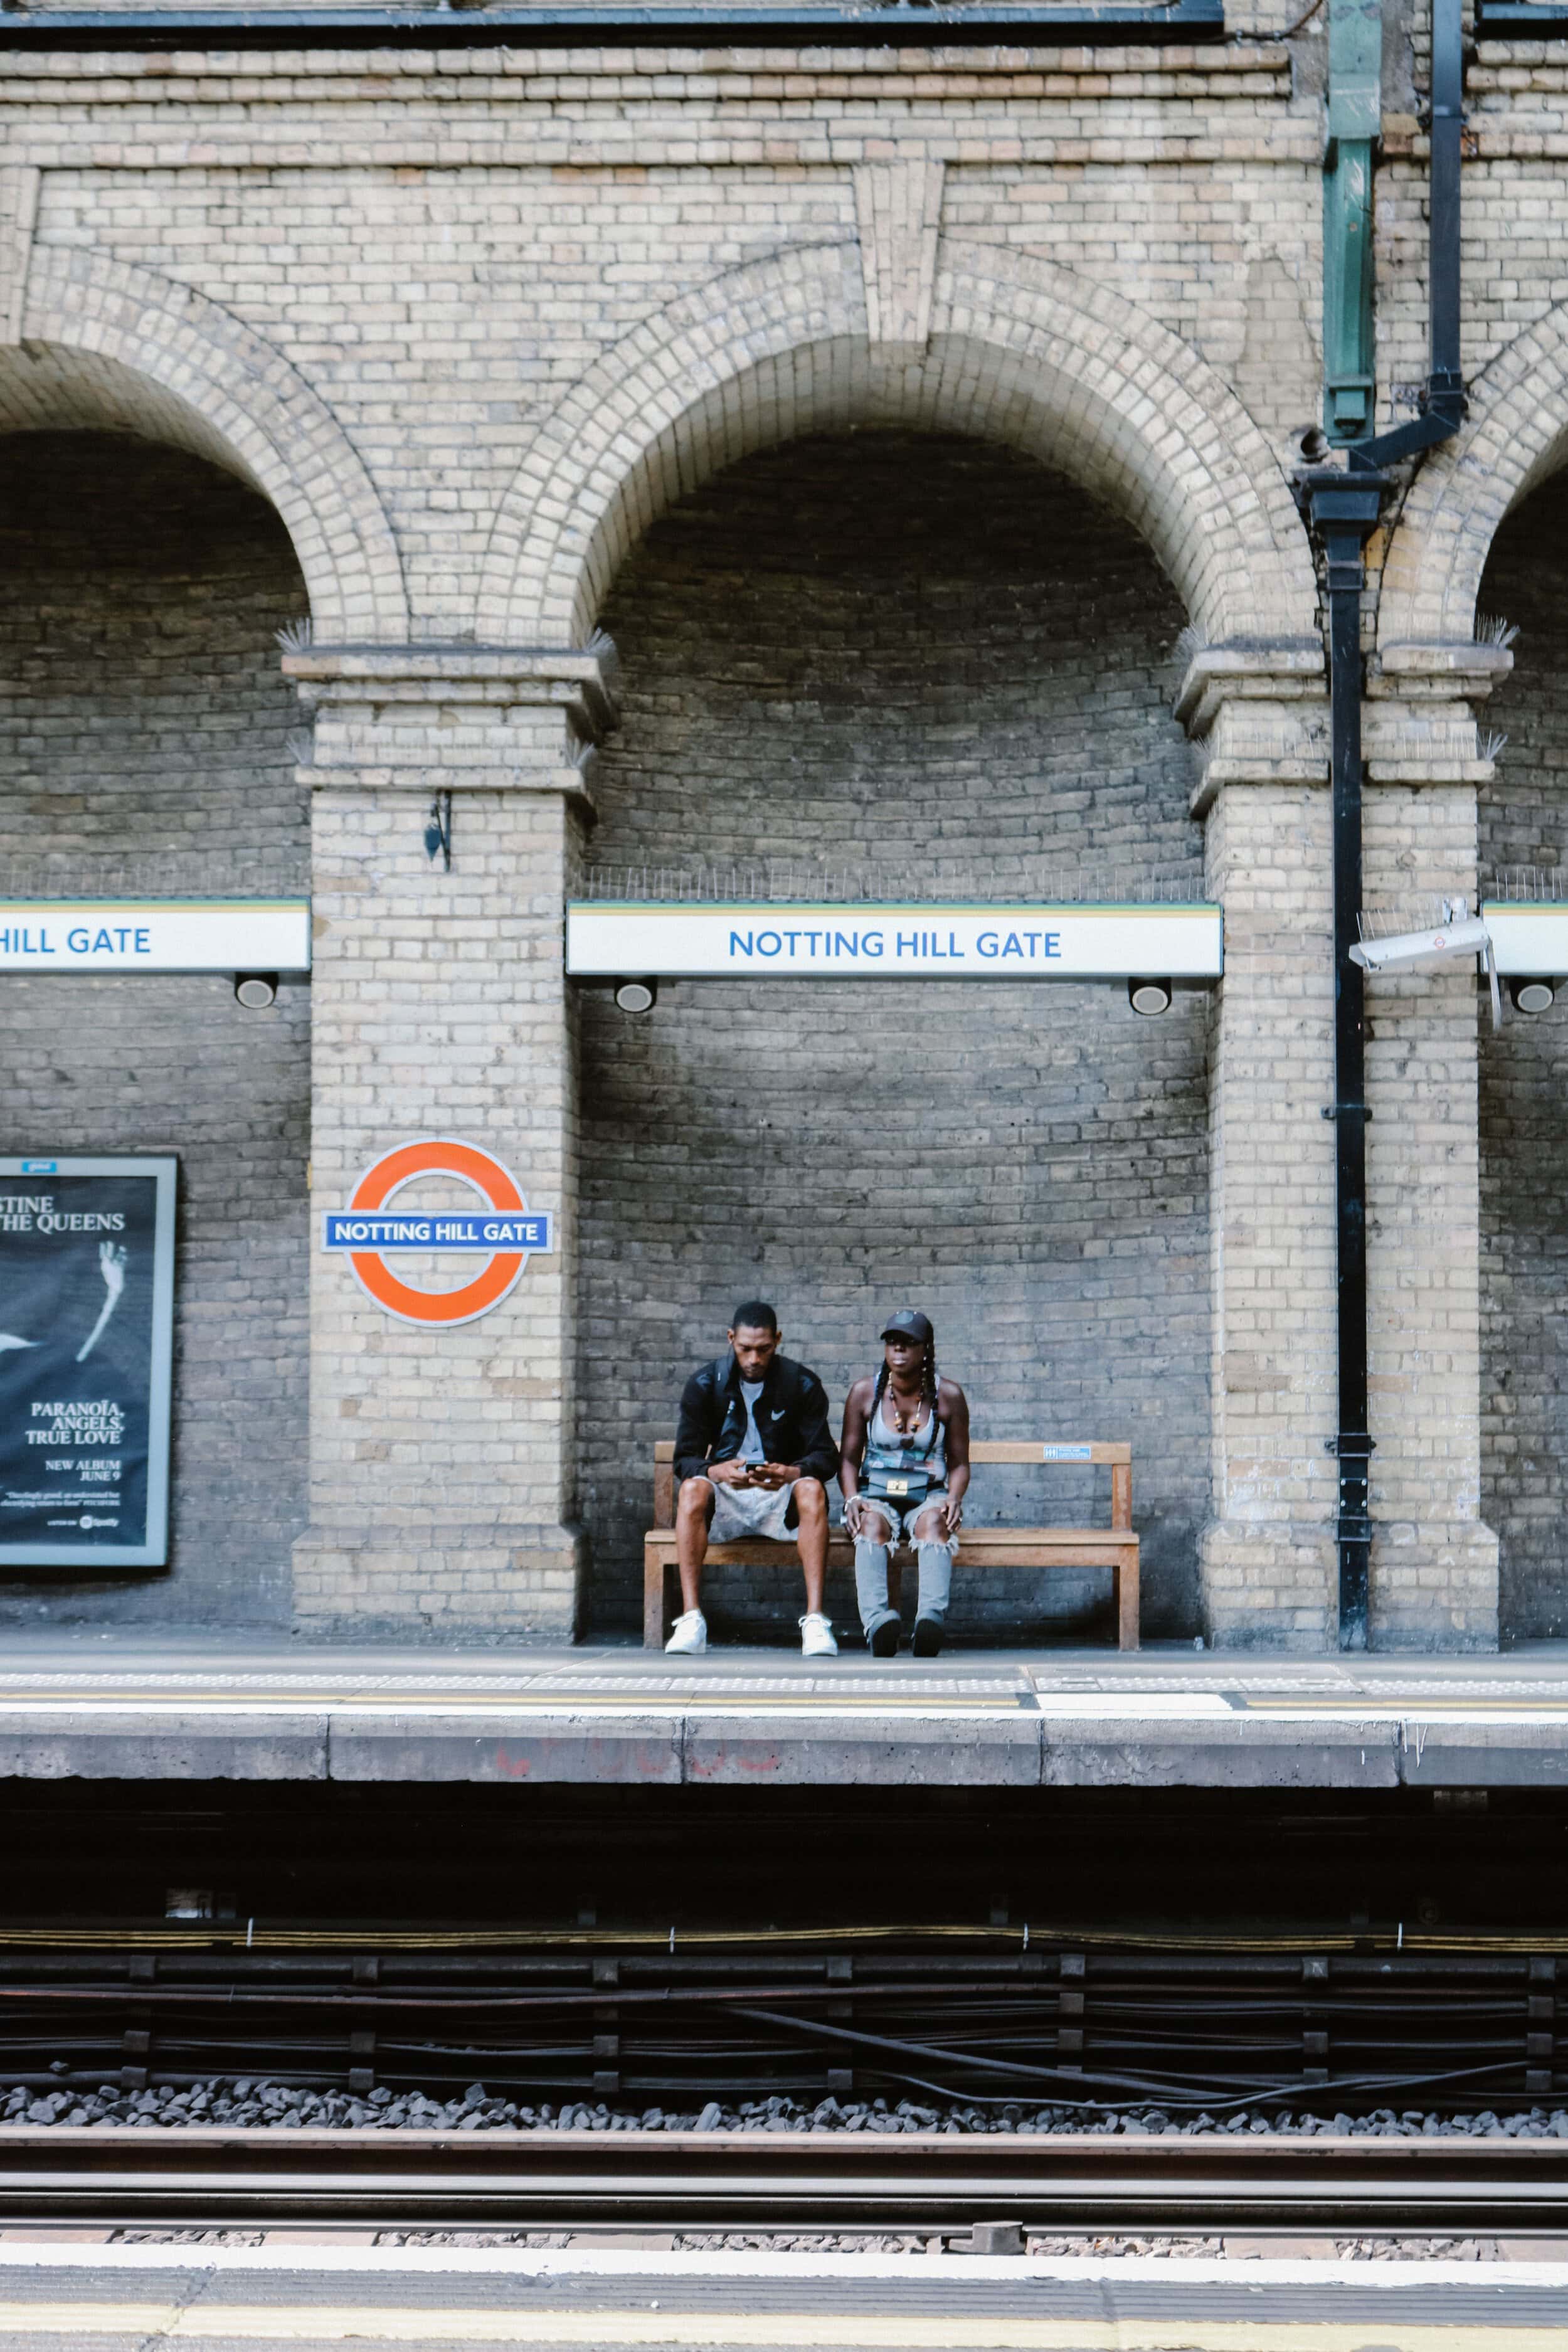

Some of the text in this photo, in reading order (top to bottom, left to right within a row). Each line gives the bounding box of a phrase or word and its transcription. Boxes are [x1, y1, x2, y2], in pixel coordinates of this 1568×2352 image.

[67, 928, 151, 953] GATE
[729, 931, 1061, 958] NOTTING HILL GATE
[0, 1196, 53, 1213] TINE
[36, 1213, 125, 1234] QUEENS
[335, 1222, 538, 1241] NOTTING HILL GATE
[51, 1417, 124, 1431] ANGELS,
[25, 1430, 120, 1444] TRUE LOVE
[45, 1460, 121, 1470] NEW ALBUM
[80, 1471, 121, 1481] JUNE 9
